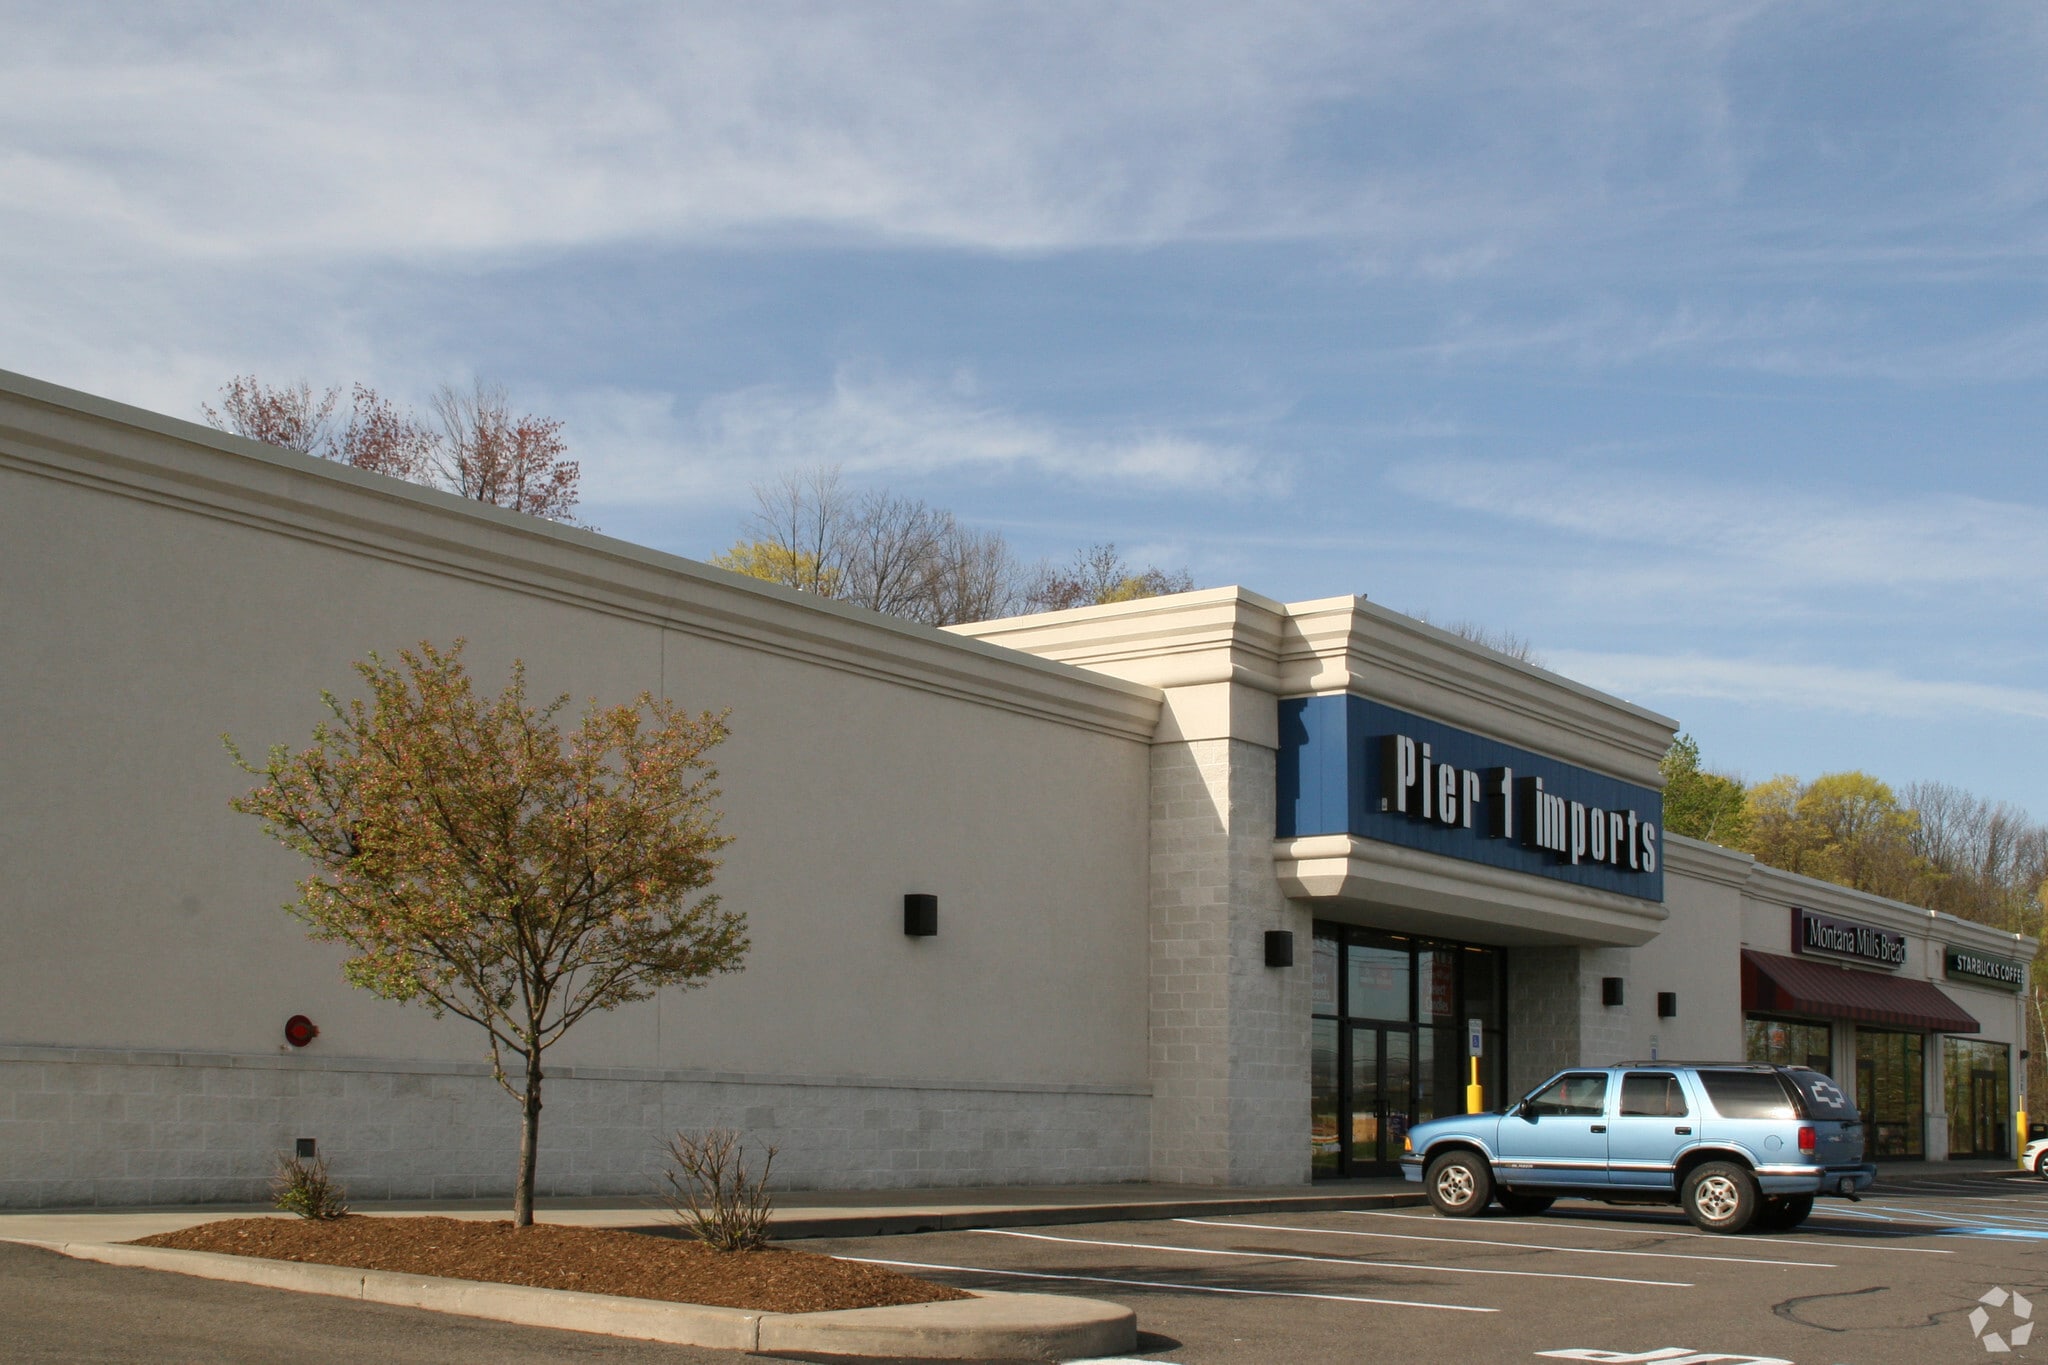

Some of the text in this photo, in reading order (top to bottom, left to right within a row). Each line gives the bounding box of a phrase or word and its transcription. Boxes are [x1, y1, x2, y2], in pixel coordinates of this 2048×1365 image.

[1396, 734, 1656, 873] Pier 1 imports
[1809, 917, 1855, 953] Montana
[1856, 927, 1879, 958] Mills
[1957, 954, 2024, 984] STARBUCKS COFFEE
